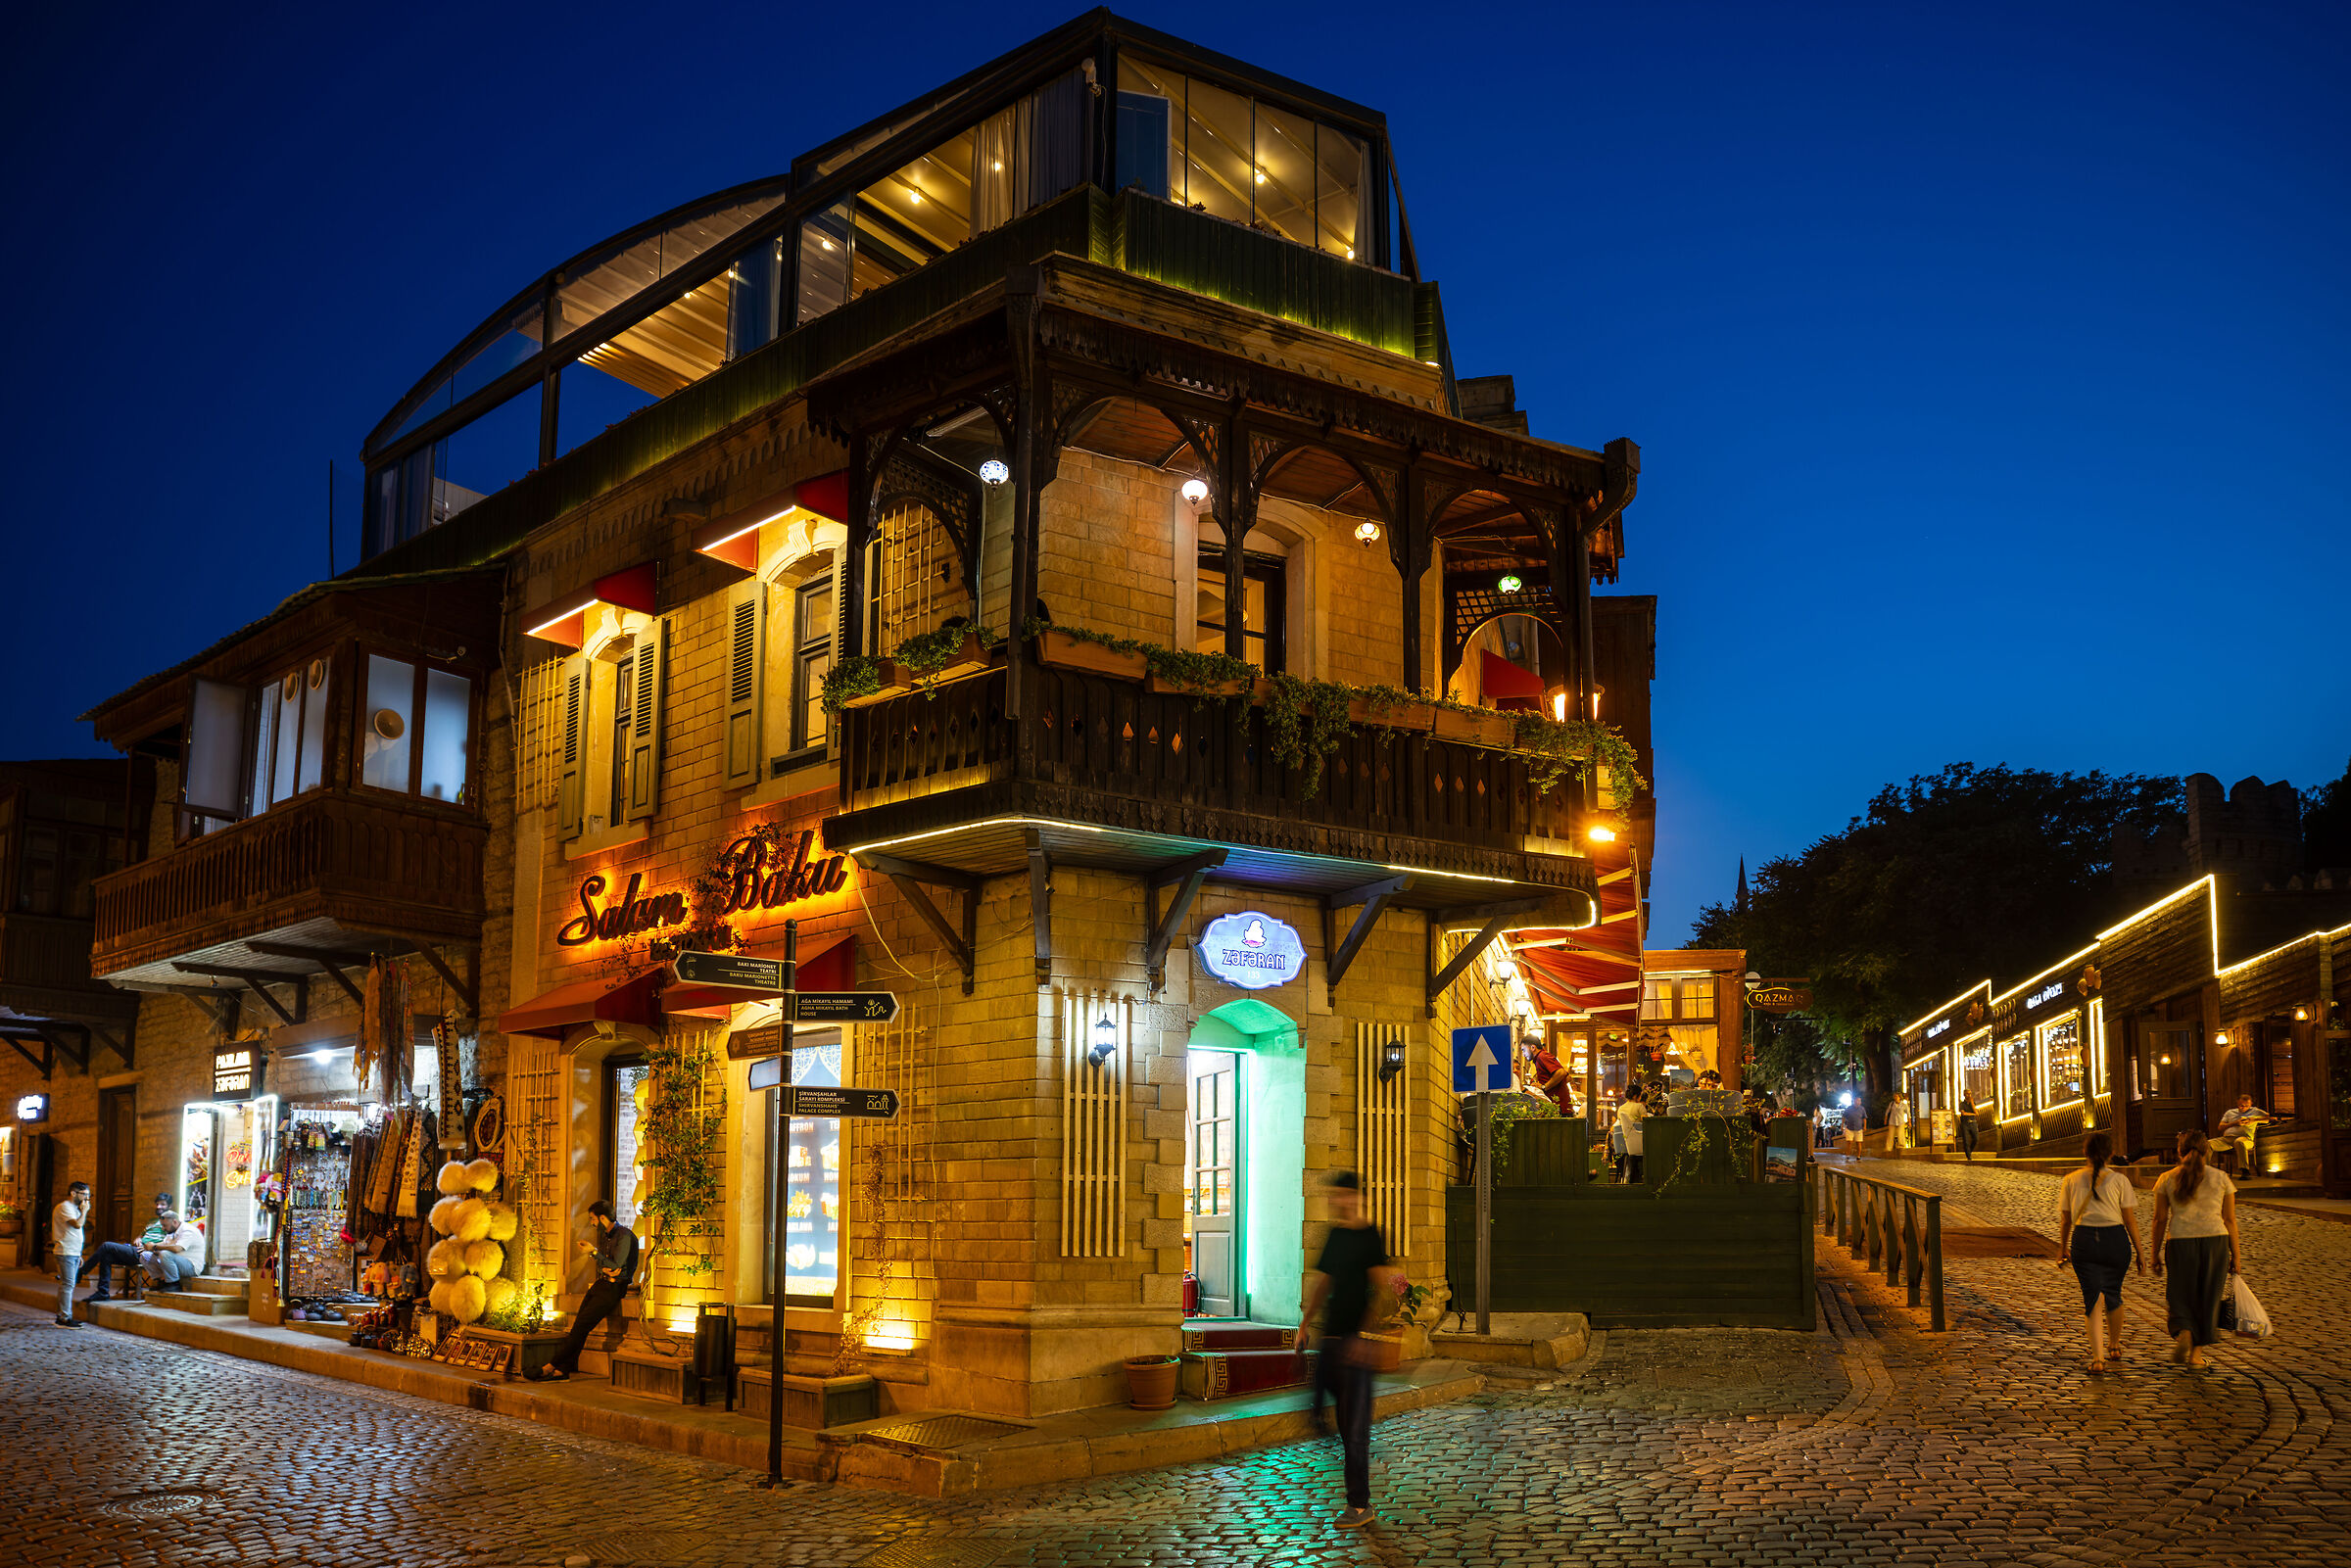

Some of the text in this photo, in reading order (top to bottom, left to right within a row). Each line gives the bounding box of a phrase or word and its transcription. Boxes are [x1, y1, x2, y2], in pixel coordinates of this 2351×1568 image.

[557, 830, 848, 946] Salam Baku
[1223, 948, 1285, 970] ZƏFƏRAN
